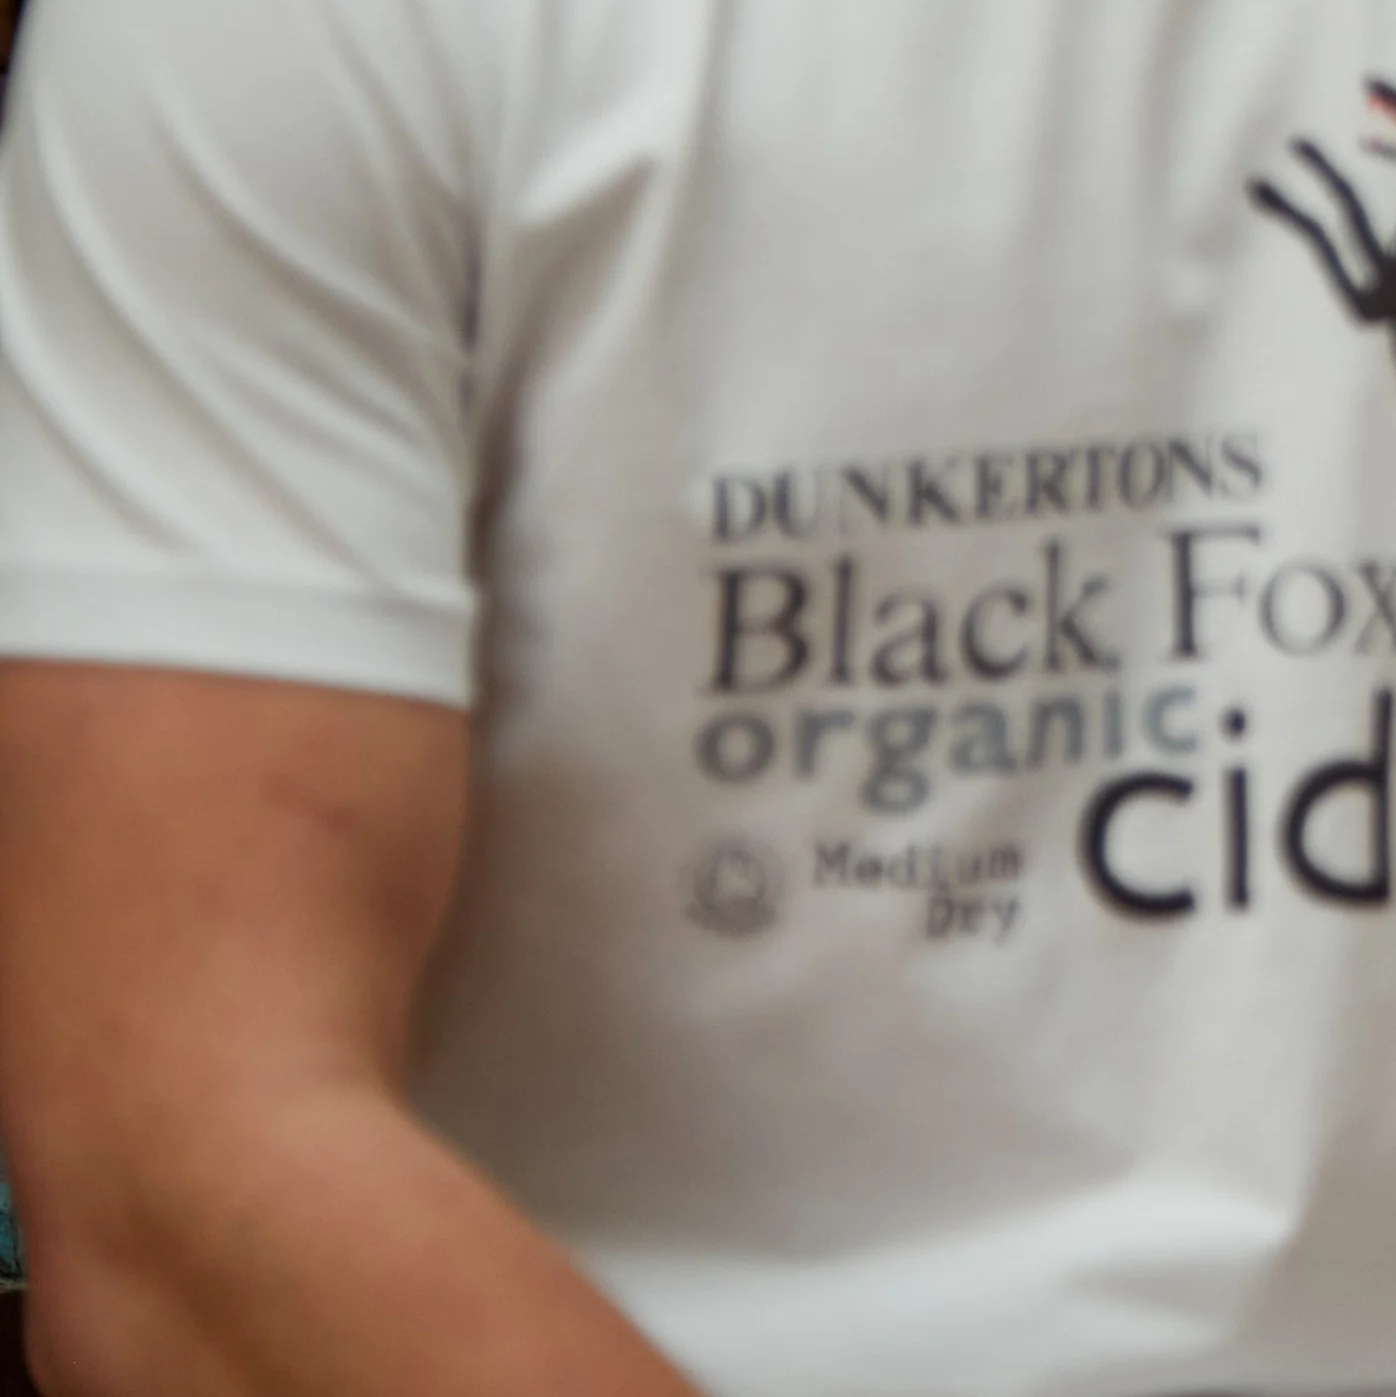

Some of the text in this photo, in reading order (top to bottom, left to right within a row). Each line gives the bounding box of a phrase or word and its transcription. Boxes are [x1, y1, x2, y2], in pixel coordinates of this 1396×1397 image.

[710, 430, 1268, 545] DUNKERTONS
[699, 539, 1122, 699] Black
[693, 685, 1200, 814] organic
[812, 841, 1024, 888] Medium
[923, 897, 1022, 944] Dry
